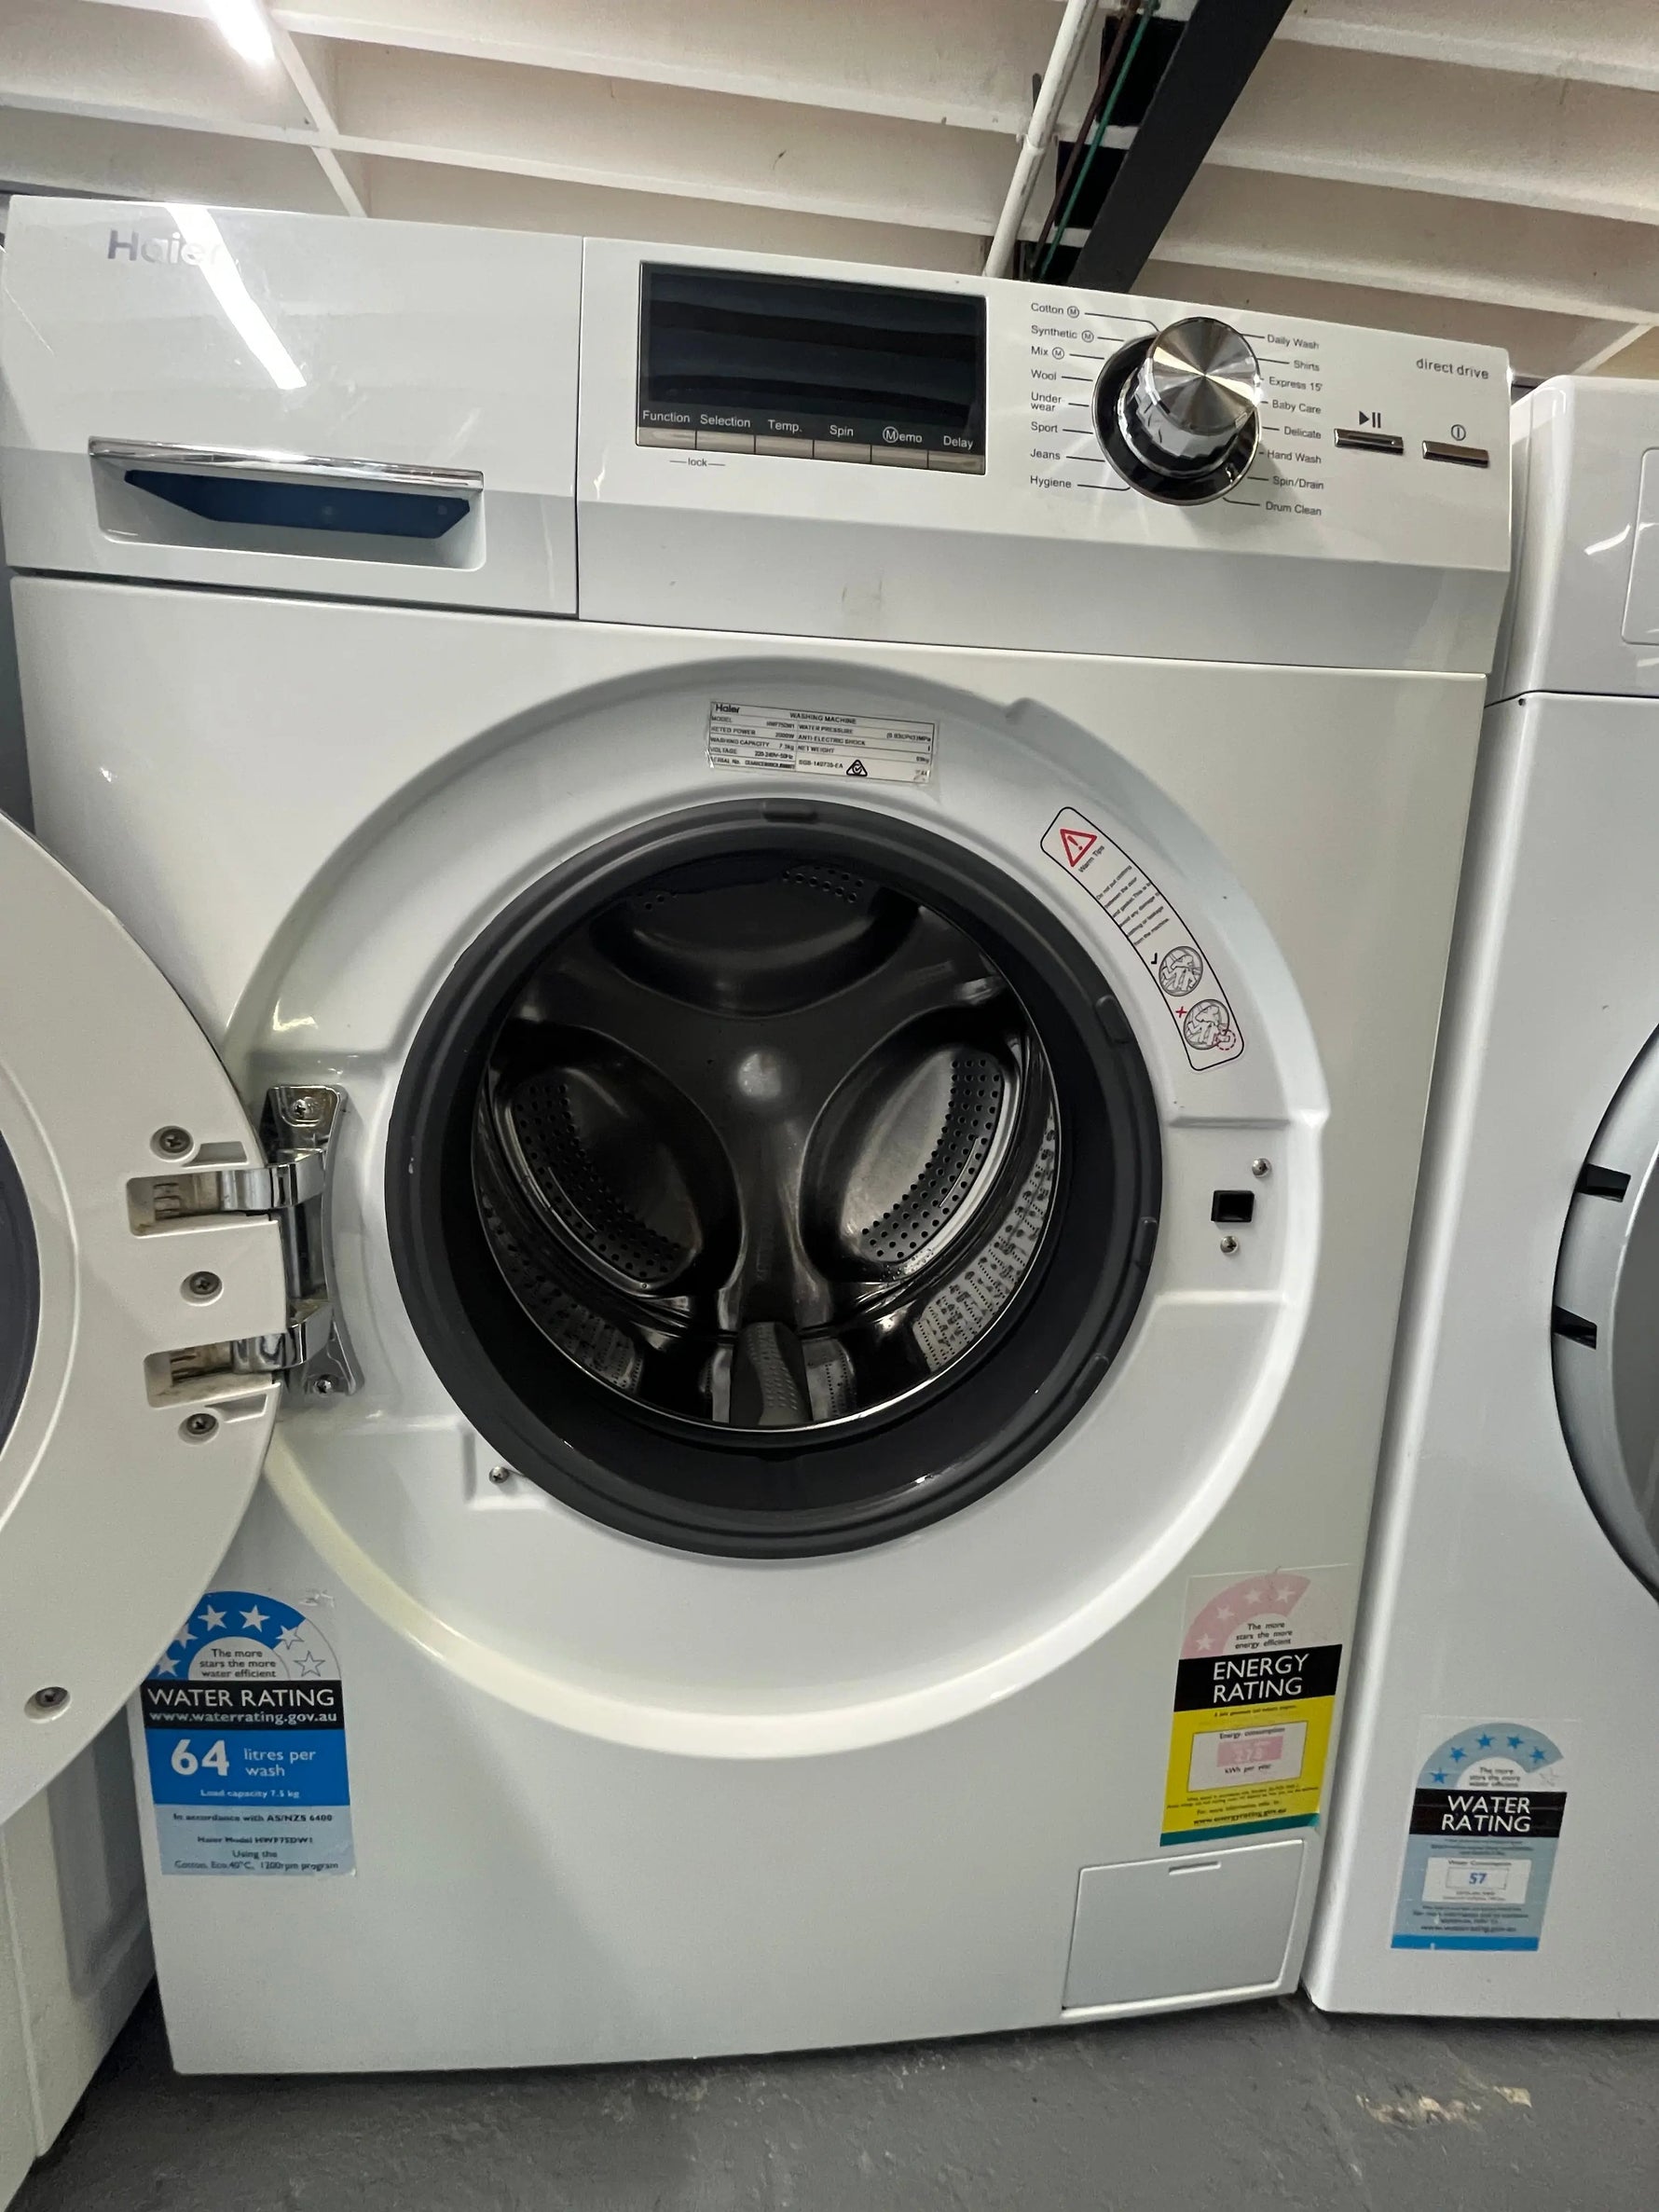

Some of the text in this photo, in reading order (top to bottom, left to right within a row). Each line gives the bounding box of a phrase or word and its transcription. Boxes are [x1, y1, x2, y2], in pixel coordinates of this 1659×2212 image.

[1031, 303, 1064, 315] Cotton
[1031, 324, 1077, 339] Synthetic
[1268, 334, 1320, 350] Daily Wash
[1031, 346, 1049, 356] Mix
[1294, 360, 1320, 372] Shirts
[1416, 358, 1489, 379] direct drive
[1031, 369, 1057, 380] Wool
[1269, 377, 1306, 390] Express
[1031, 403, 1055, 412] wear
[1272, 399, 1322, 415] Baby Care
[642, 410, 691, 423] Function
[700, 414, 751, 429] Selection
[768, 419, 802, 434] Temp.
[830, 424, 854, 438] Spin
[1031, 421, 1058, 433] Sport
[1284, 426, 1322, 439] Delicate
[943, 435, 973, 450] Delay
[1031, 448, 1061, 460] Jeans
[1267, 450, 1322, 464] Hand Wash
[688, 457, 708, 467] lock
[1030, 475, 1072, 488] Hygiene
[1272, 475, 1324, 489] Spin/Drain
[1266, 501, 1322, 516] Drum Clean
[715, 703, 740, 713] Haier
[789, 712, 857, 725] WASHING MACHINE
[820, 726, 854, 735] PRESSURE
[739, 739, 770, 748] CAPACITY
[844, 737, 866, 746] SHOCK
[1078, 857, 1095, 872] Warm
[211, 1648, 232, 1657] The
[228, 1659, 245, 1668] the
[1213, 1653, 1309, 1681] ENERGY
[235, 1669, 277, 1678] efficient
[1213, 1677, 1303, 1704] RATING
[147, 1688, 335, 1708] WATER RATING
[149, 1711, 337, 1725] www.waterrating.gov.au
[1219, 1731, 1241, 1739] Energy
[171, 1738, 229, 1777] 64
[243, 1748, 317, 1764] litres per
[245, 1764, 285, 1777] wash
[199, 1789, 225, 1797] Load
[226, 1790, 267, 1799] capacity
[287, 1790, 300, 1799] kg
[1447, 1795, 1530, 1814] WATER
[242, 1813, 265, 1821] with
[1441, 1814, 1531, 1833] RATING
[232, 1850, 260, 1860] Using
[1469, 1873, 1488, 1885] 57
